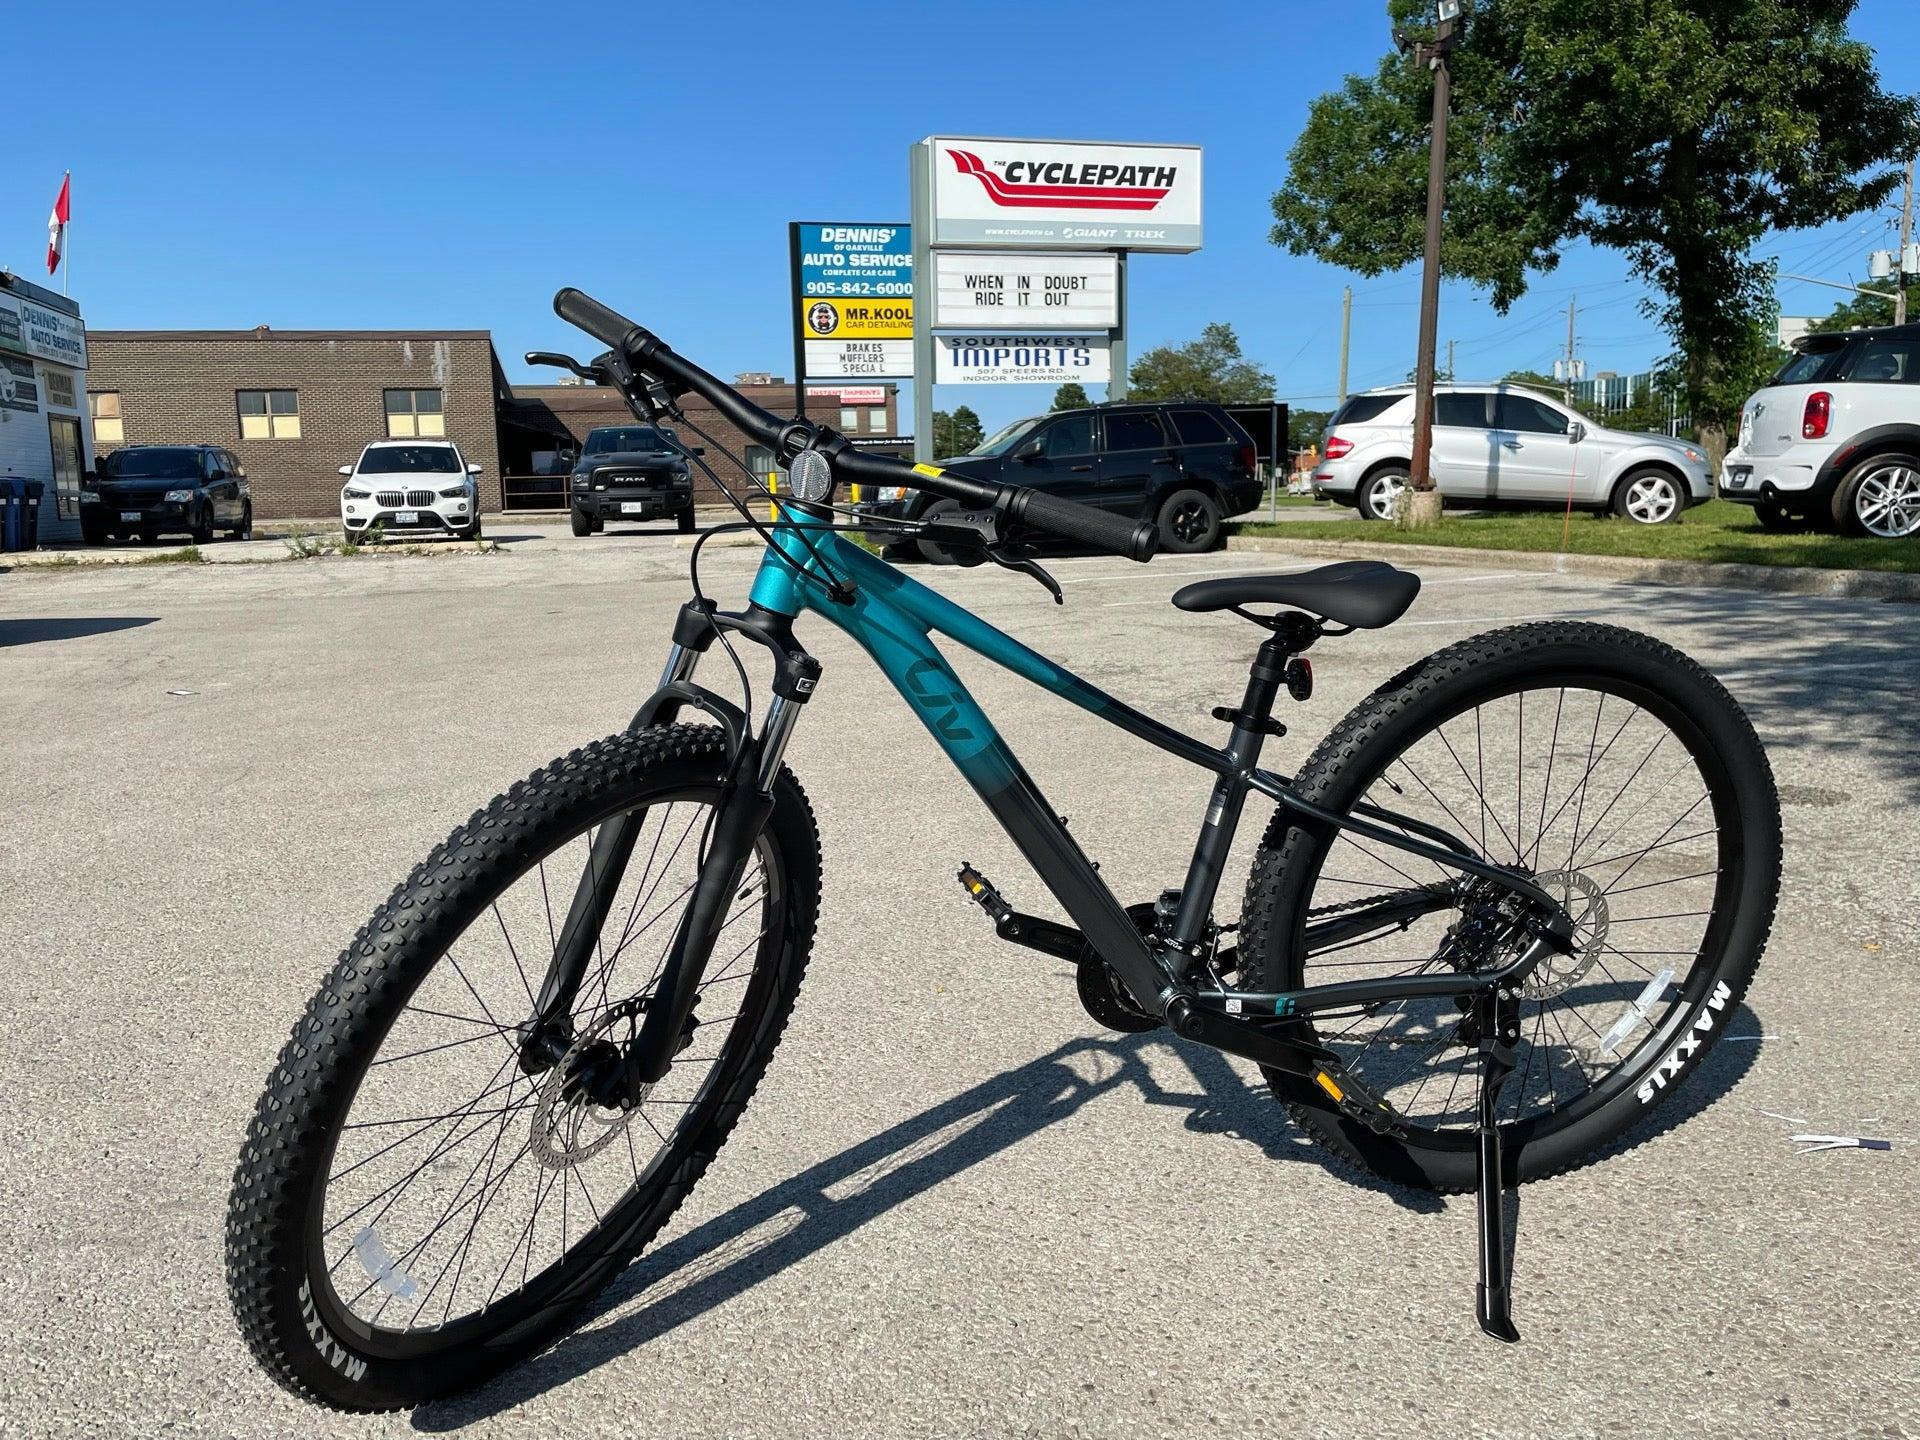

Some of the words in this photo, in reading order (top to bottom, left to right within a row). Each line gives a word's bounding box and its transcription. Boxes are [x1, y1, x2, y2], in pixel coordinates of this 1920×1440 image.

[1005, 161, 1177, 188] CYCLEPATH
[821, 227, 896, 243] DENNIS'
[1073, 228, 1118, 238] GIANT
[1124, 230, 1166, 239] TREK
[803, 253, 845, 266] AUTO
[849, 254, 913, 267] SERVICE
[806, 281, 913, 294] 905-842-6000
[965, 275, 1004, 289] WHEN
[1017, 276, 1030, 289] IN
[1044, 276, 1088, 290] DOUBT
[975, 292, 1004, 306] RIDE
[1018, 293, 1030, 306] IT
[1044, 293, 1070, 306] OUT
[845, 308, 913, 320] MR.KOOL
[846, 321, 865, 329] CAR
[867, 321, 914, 329] DETAILING
[30, 328, 51, 346] AUTO
[53, 334, 82, 355] SERVICE
[846, 343, 883, 353] BRAKES
[951, 337, 1091, 347] SOUTHWEST
[840, 354, 884, 362] MUFFLERS
[952, 348, 1091, 367] IMPORTS
[1637, 979, 1732, 1105] MAXXIS
[298, 1274, 368, 1382] MAXXIS
